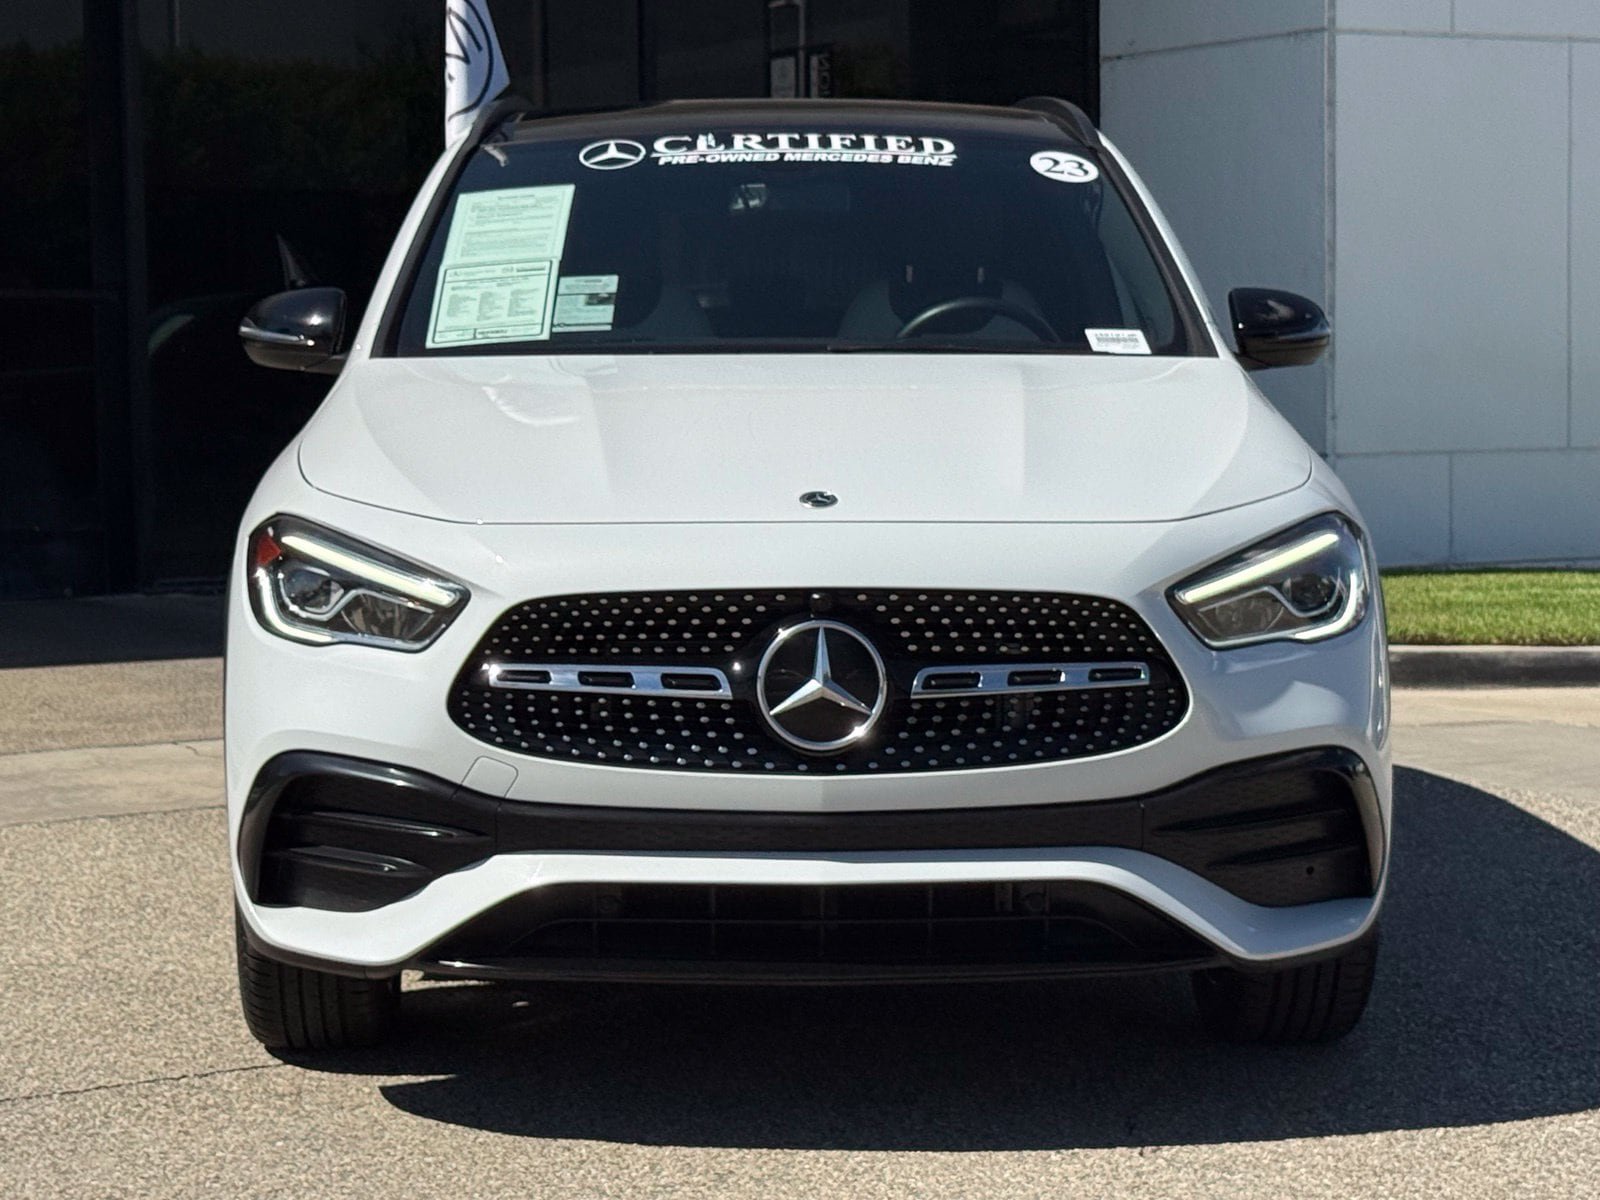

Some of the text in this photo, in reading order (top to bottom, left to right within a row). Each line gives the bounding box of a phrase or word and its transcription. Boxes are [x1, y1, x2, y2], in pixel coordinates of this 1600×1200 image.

[657, 152, 954, 167] PRE-OWNED MERCEDES BENZ
[1039, 156, 1089, 178] 23
